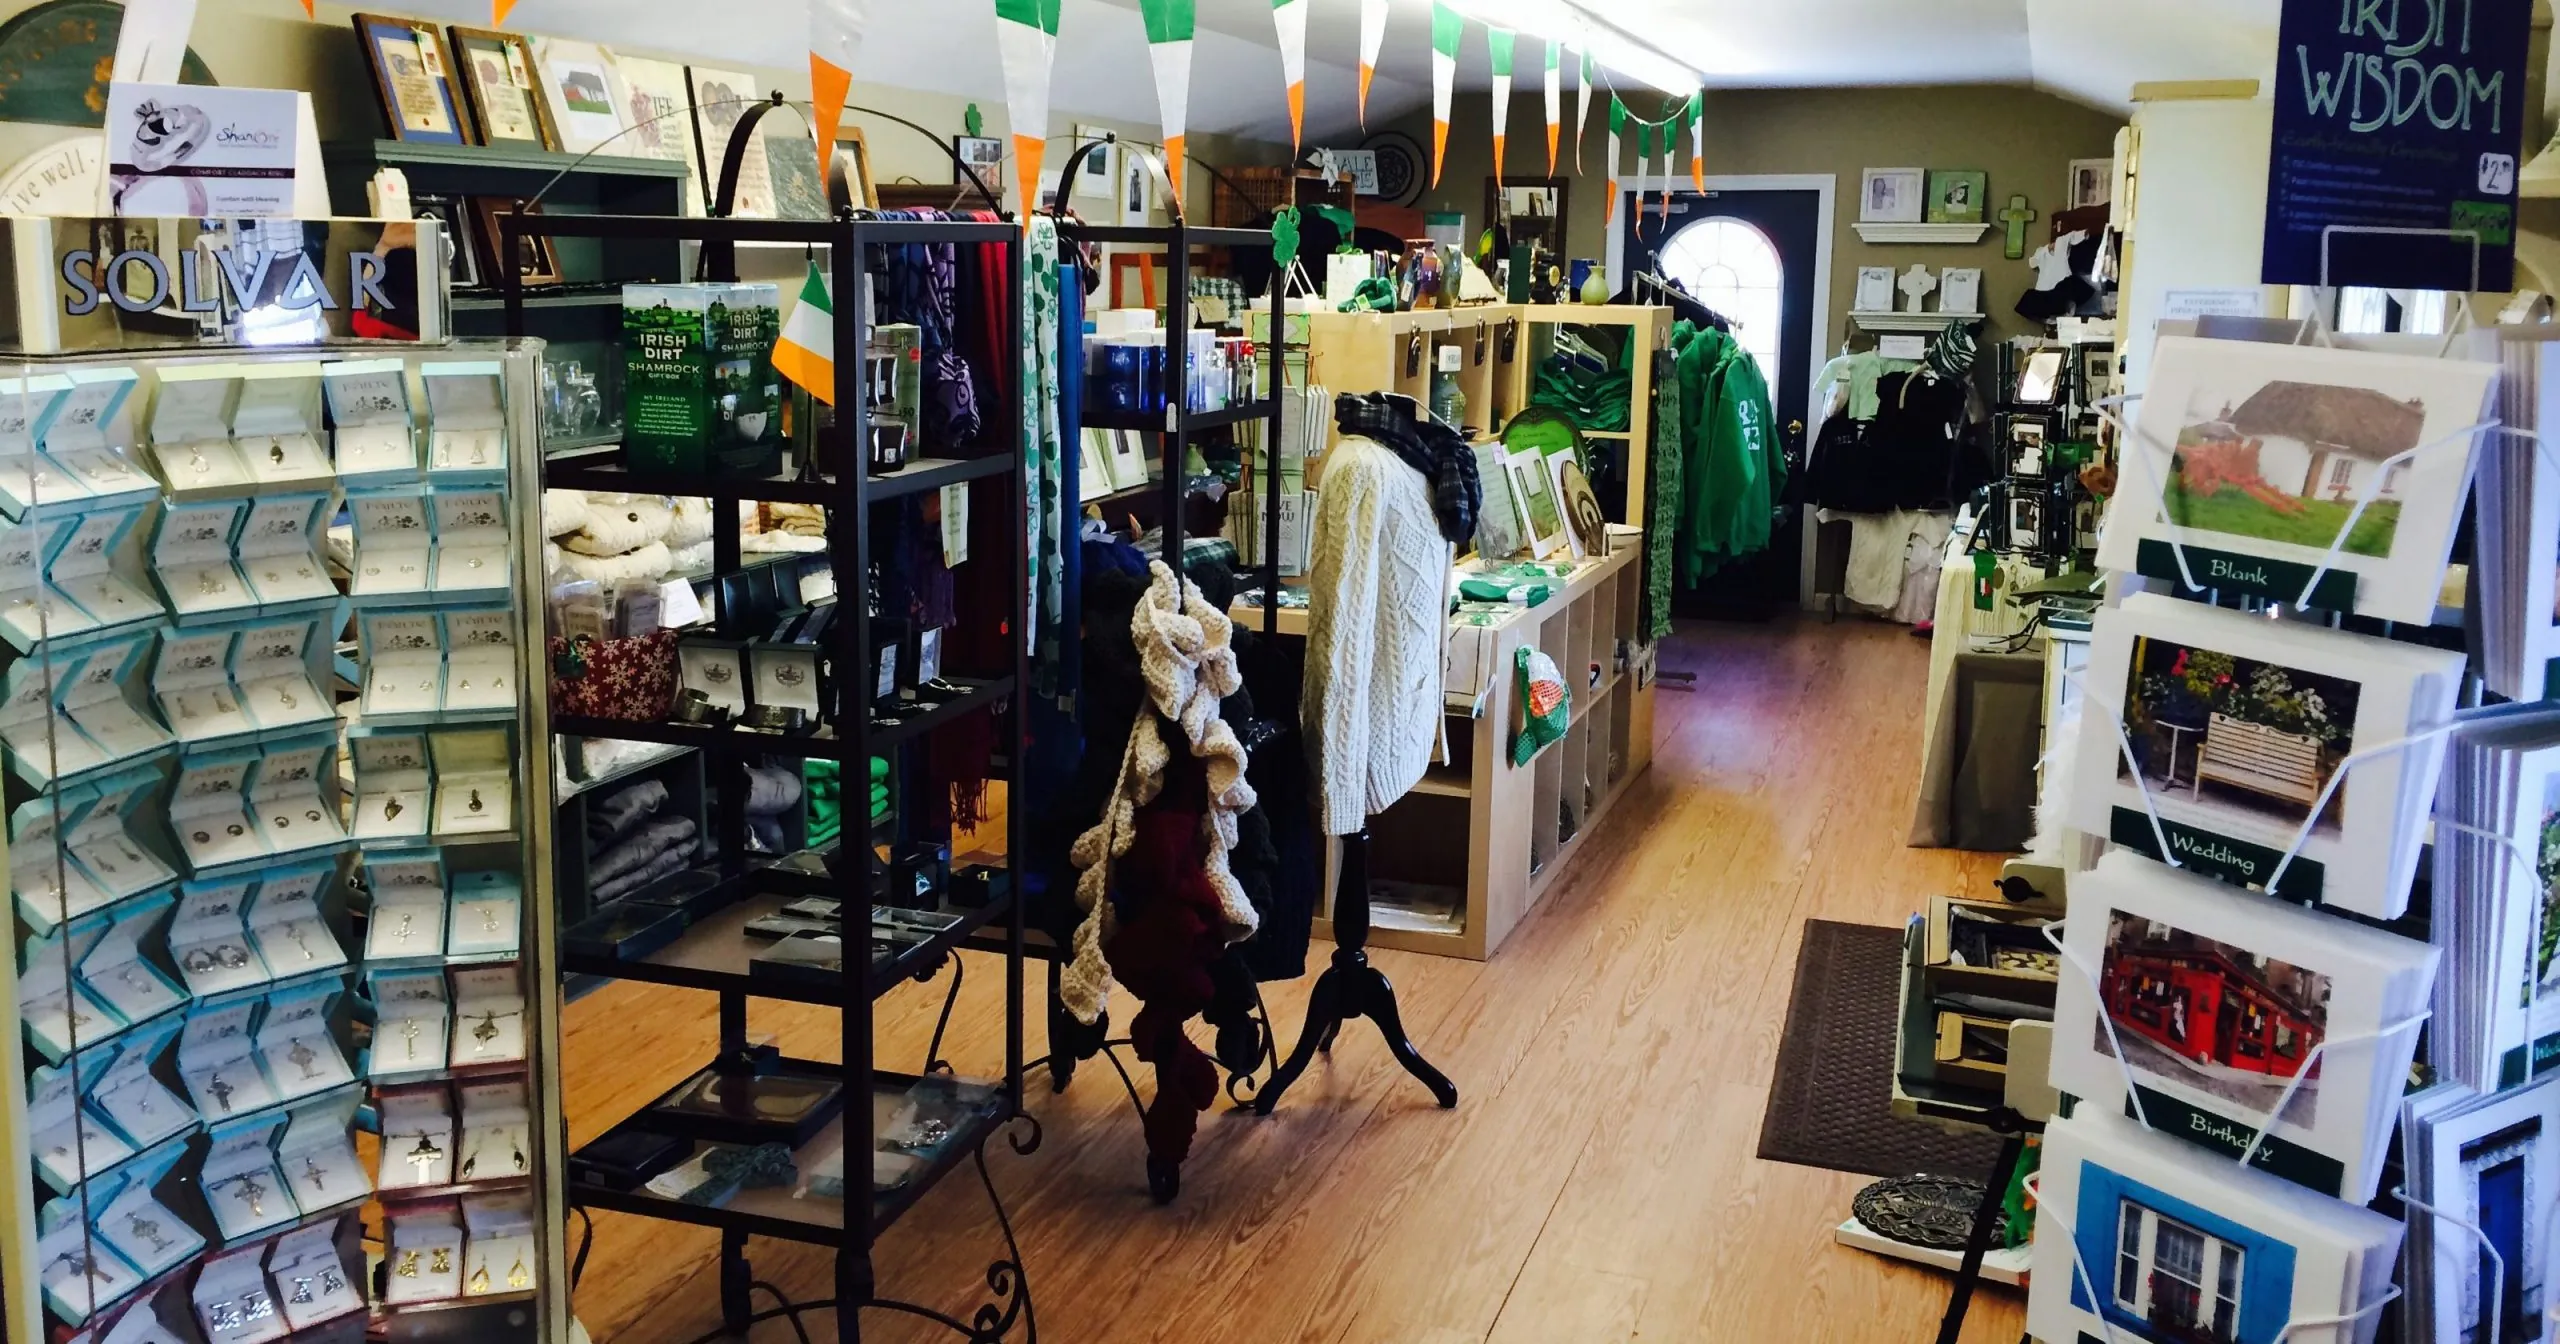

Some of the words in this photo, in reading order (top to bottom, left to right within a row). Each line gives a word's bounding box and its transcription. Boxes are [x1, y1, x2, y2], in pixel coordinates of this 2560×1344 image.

[2297, 44, 2505, 133] WISDOM
[61, 249, 397, 316] SOLVAR
[730, 313, 761, 327] IRISH
[639, 333, 687, 348] IRISH
[733, 327, 758, 339] DIRT
[645, 347, 683, 360] DIRT
[721, 341, 770, 353] SHAMROCK
[628, 362, 700, 374] SHAMROCK
[2210, 558, 2269, 586] Blank
[2172, 831, 2256, 876] Wedding
[2190, 1112, 2274, 1163] Birthdy
